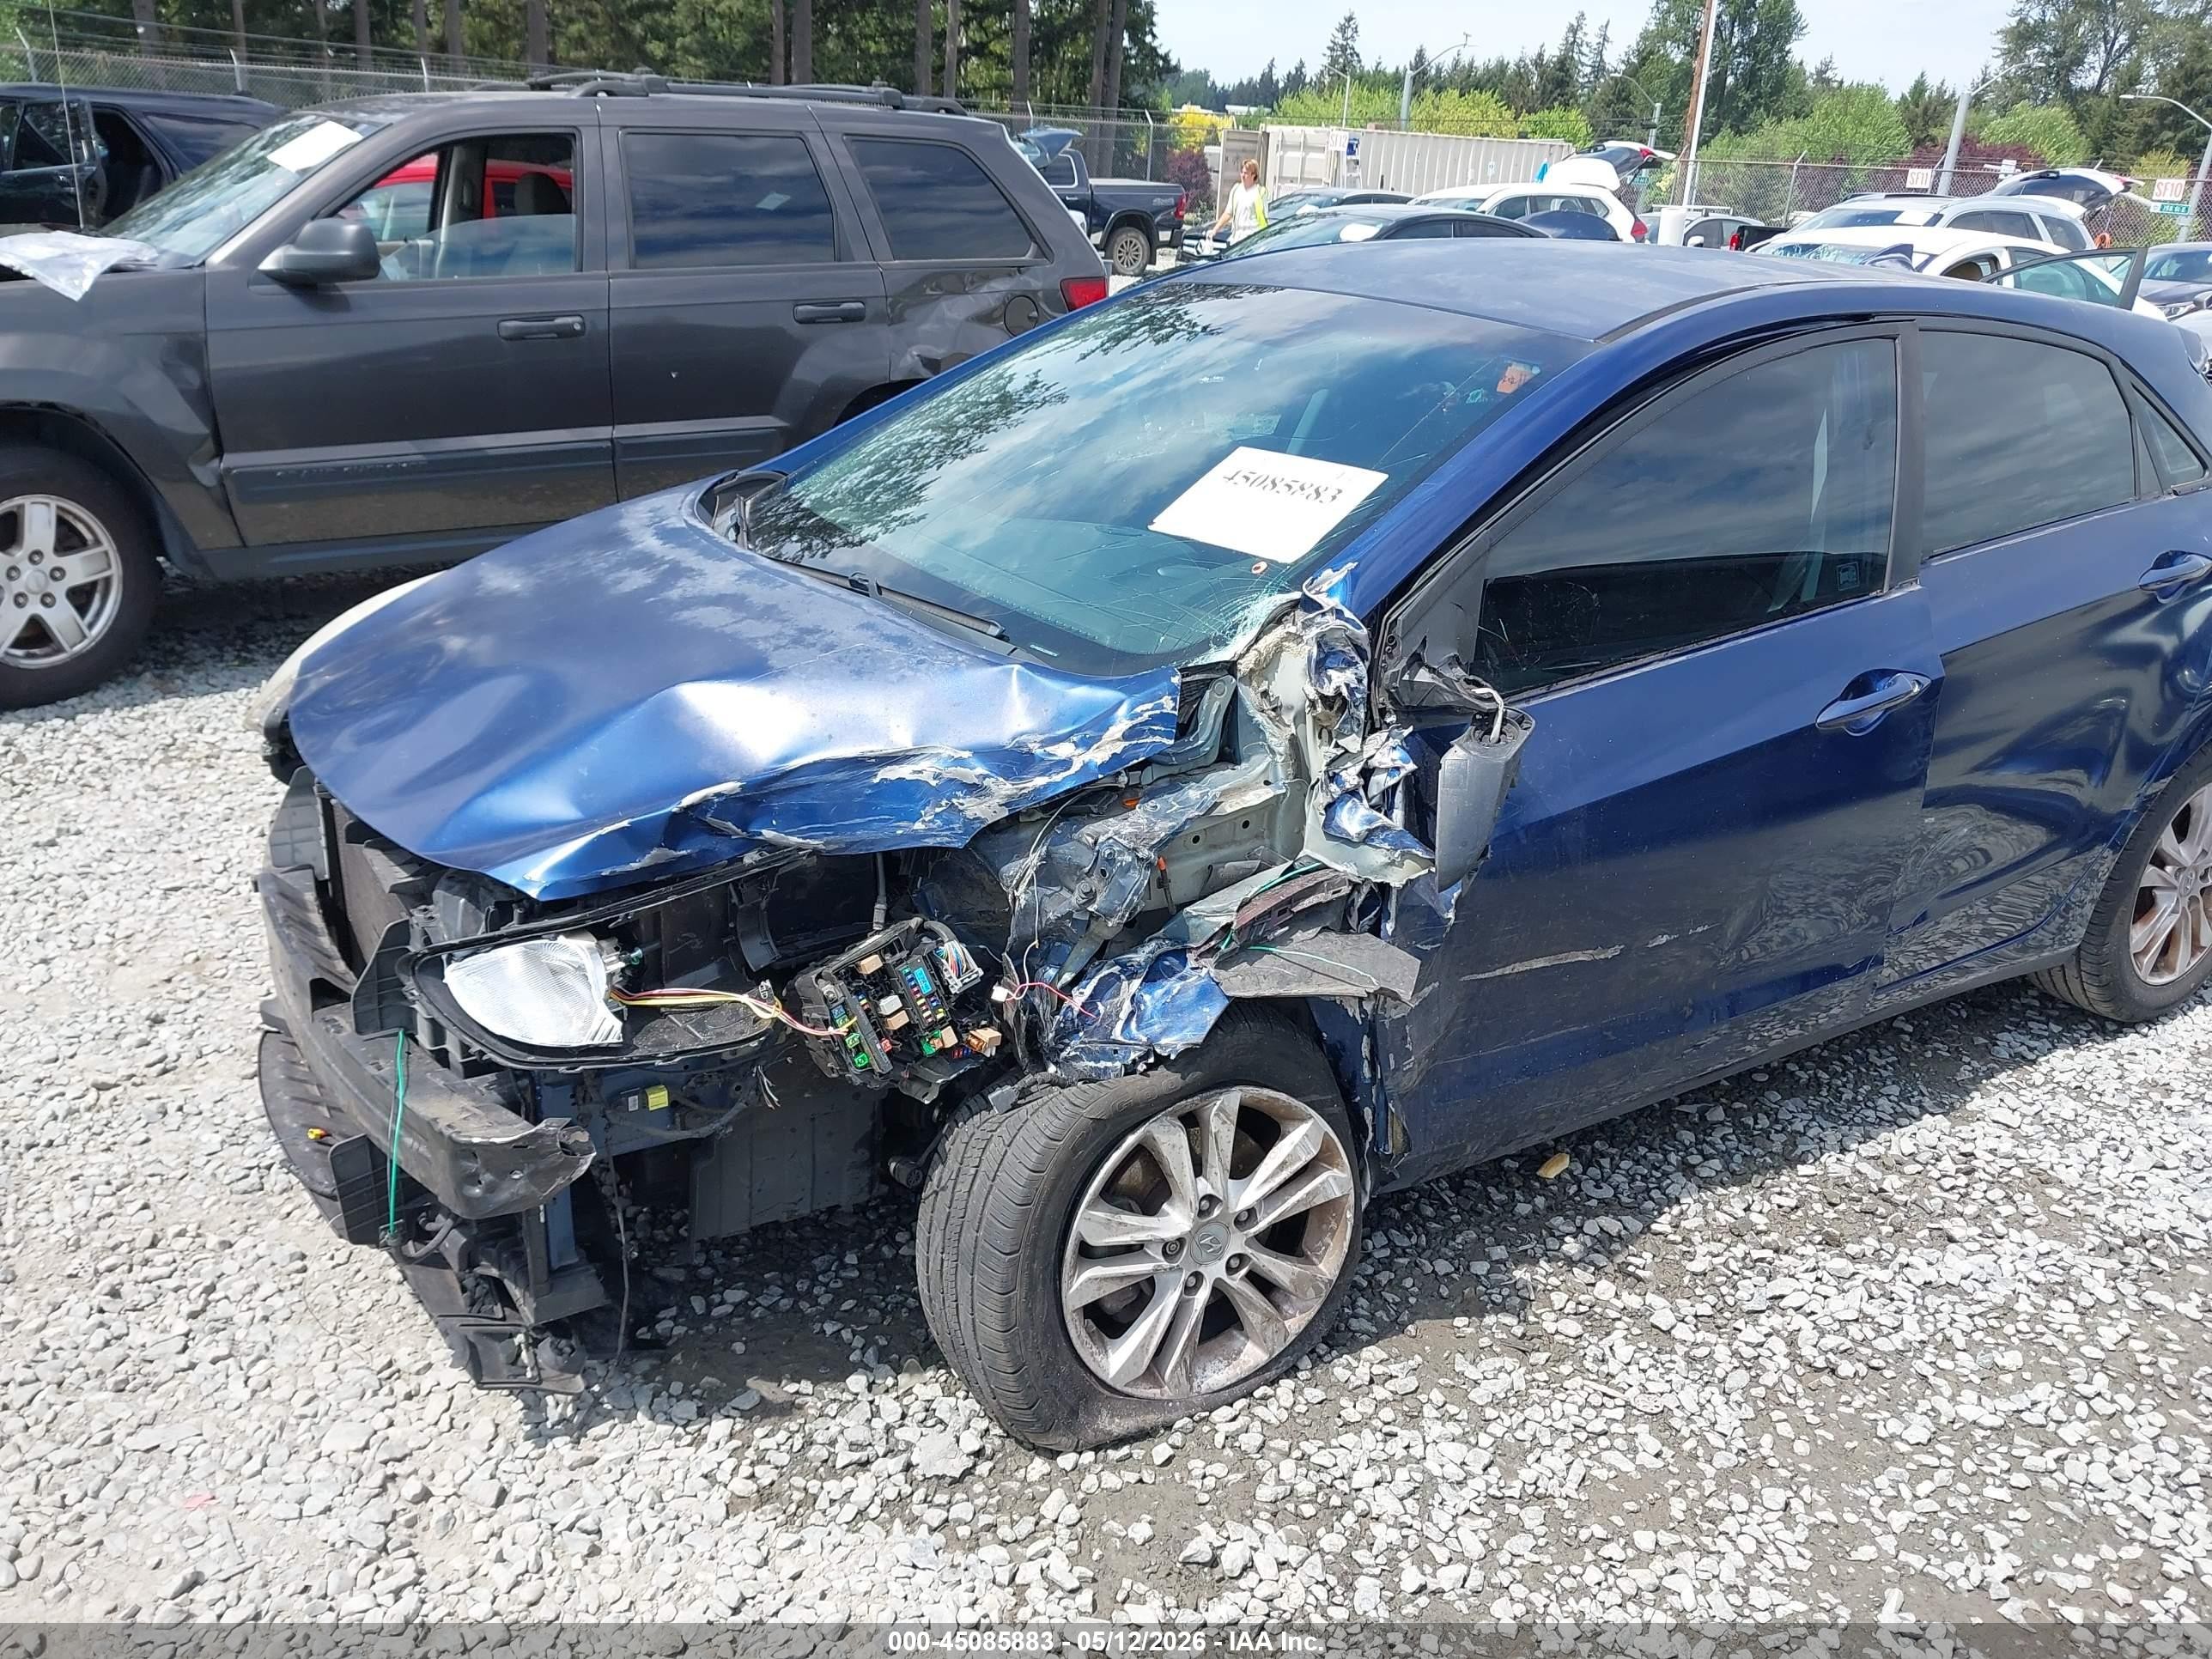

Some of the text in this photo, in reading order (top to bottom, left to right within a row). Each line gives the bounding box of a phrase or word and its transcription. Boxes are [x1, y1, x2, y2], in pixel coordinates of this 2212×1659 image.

[1909, 171, 1929, 185] SF11
[2155, 182, 2183, 198] SF10
[1223, 469, 1343, 504] 45085883
